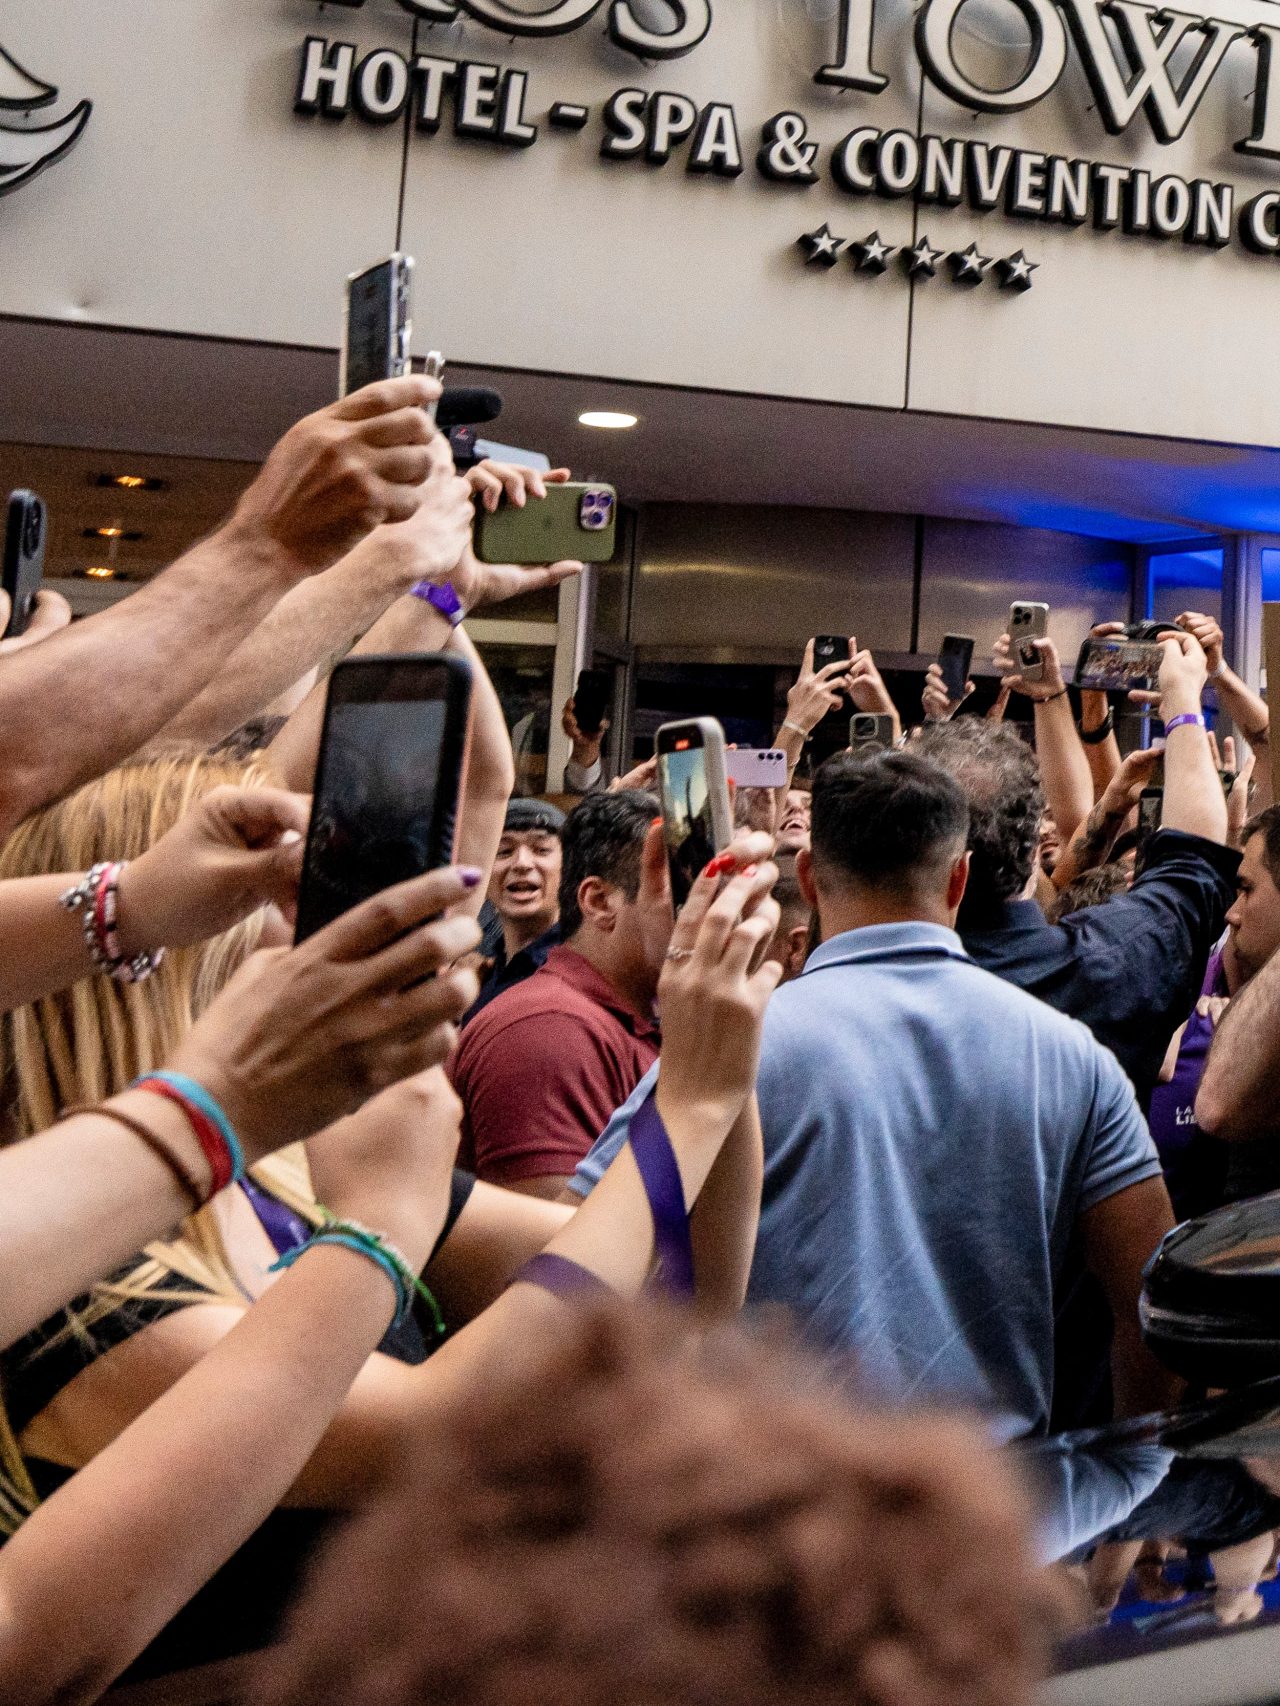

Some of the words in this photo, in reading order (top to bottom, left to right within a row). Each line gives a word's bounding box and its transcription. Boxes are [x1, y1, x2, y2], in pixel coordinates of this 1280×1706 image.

[296, 36, 537, 147] HOTEL
[600, 87, 743, 178] SPA
[757, 111, 820, 185] &
[832, 126, 1235, 246] CONVENTION
